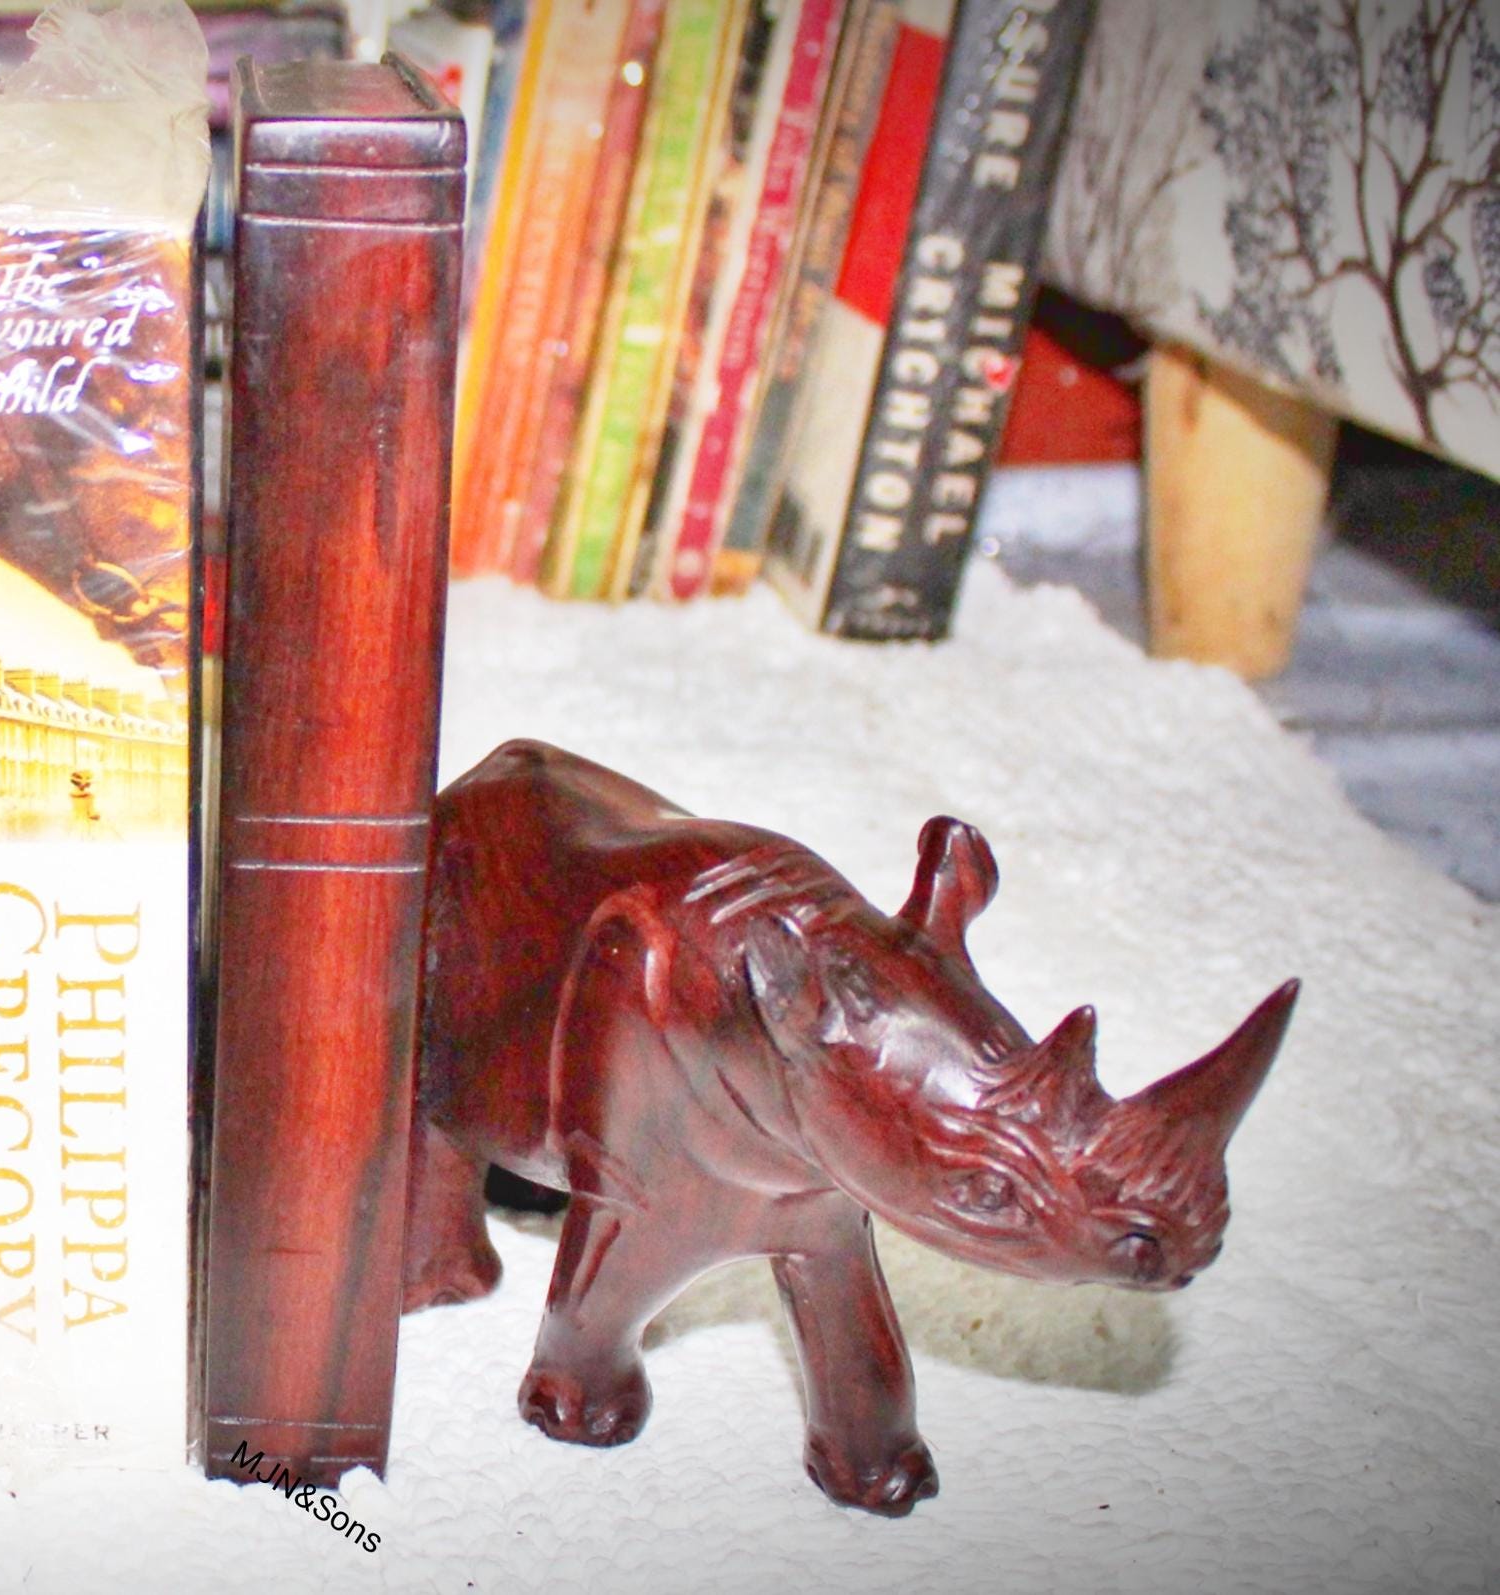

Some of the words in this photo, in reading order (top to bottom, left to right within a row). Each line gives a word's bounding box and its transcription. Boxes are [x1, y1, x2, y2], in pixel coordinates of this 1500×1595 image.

[972, 0, 1057, 190] SURE
[857, 234, 964, 552] CRICHTON
[922, 261, 1024, 544] MICHAEL
[54, 899, 142, 1332] PHILIPPA
